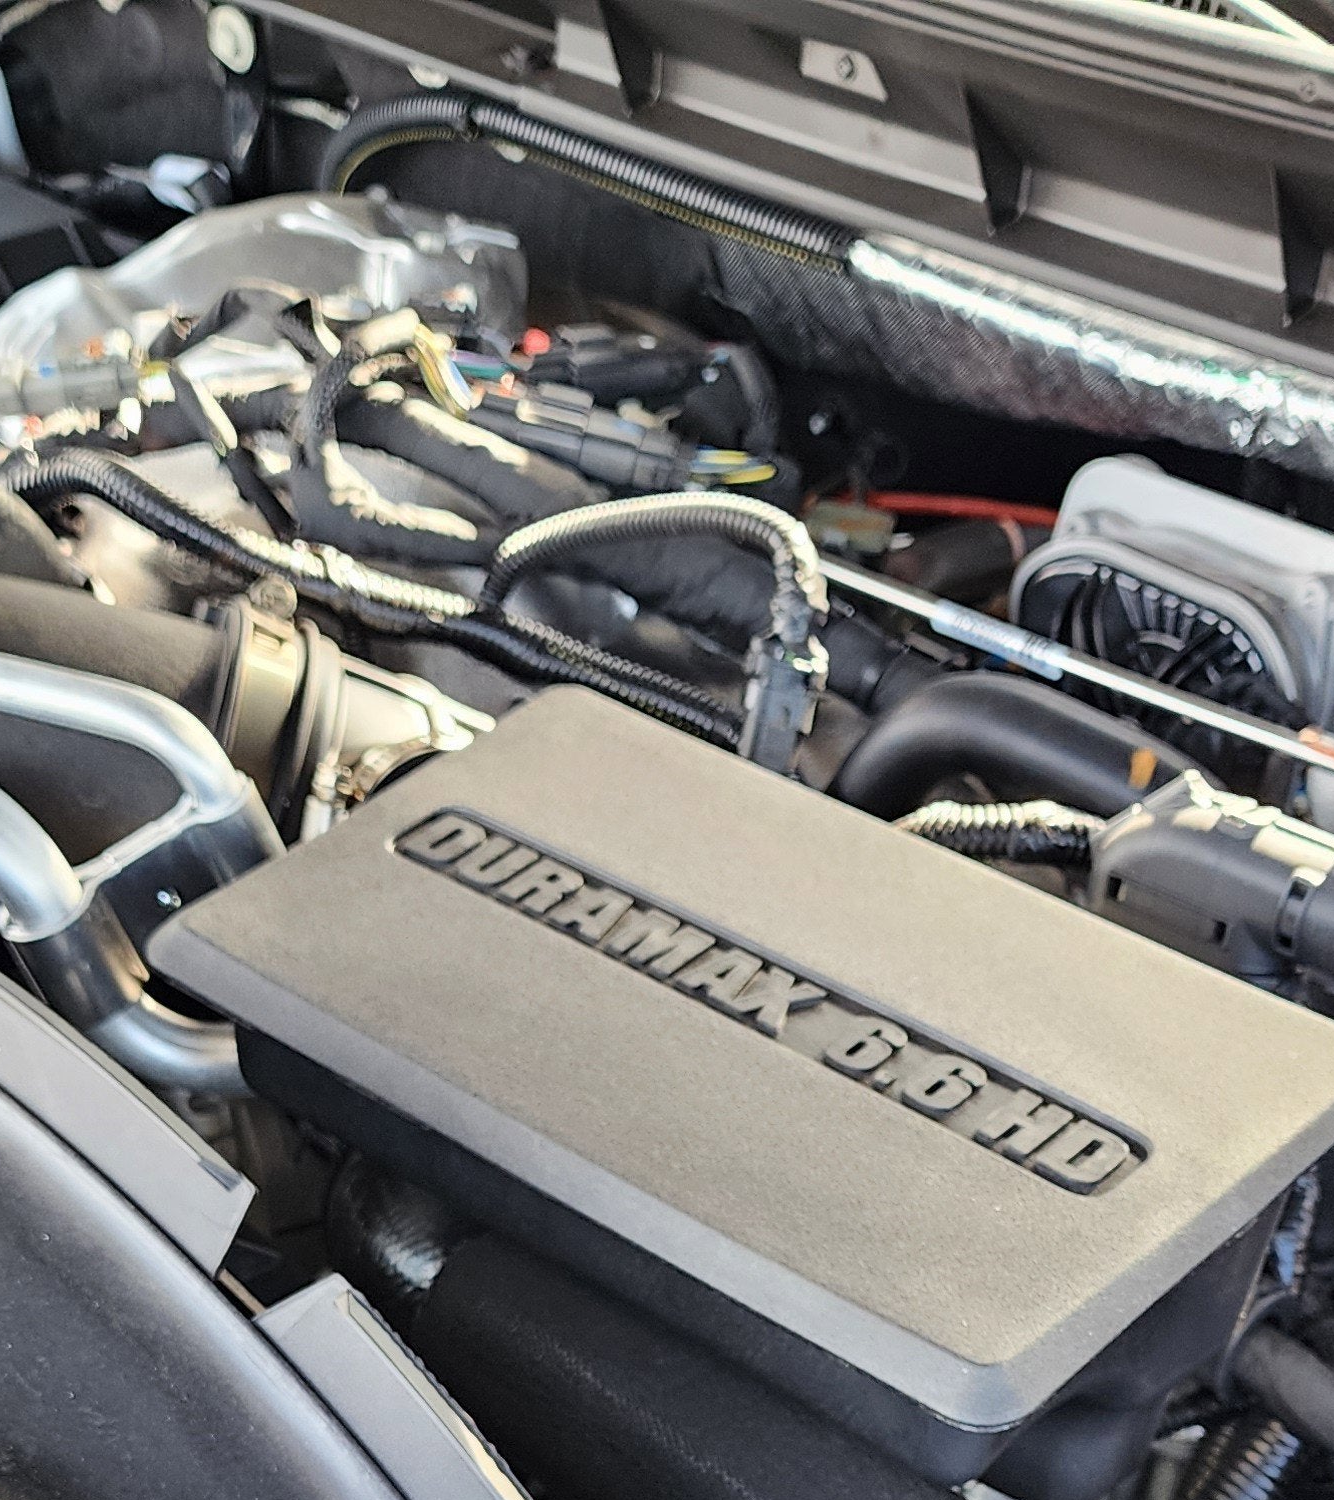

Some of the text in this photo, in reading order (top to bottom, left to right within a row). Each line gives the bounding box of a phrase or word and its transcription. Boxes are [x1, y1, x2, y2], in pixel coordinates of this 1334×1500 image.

[400, 813, 1133, 1195] DURAMAX 6.6 HD
